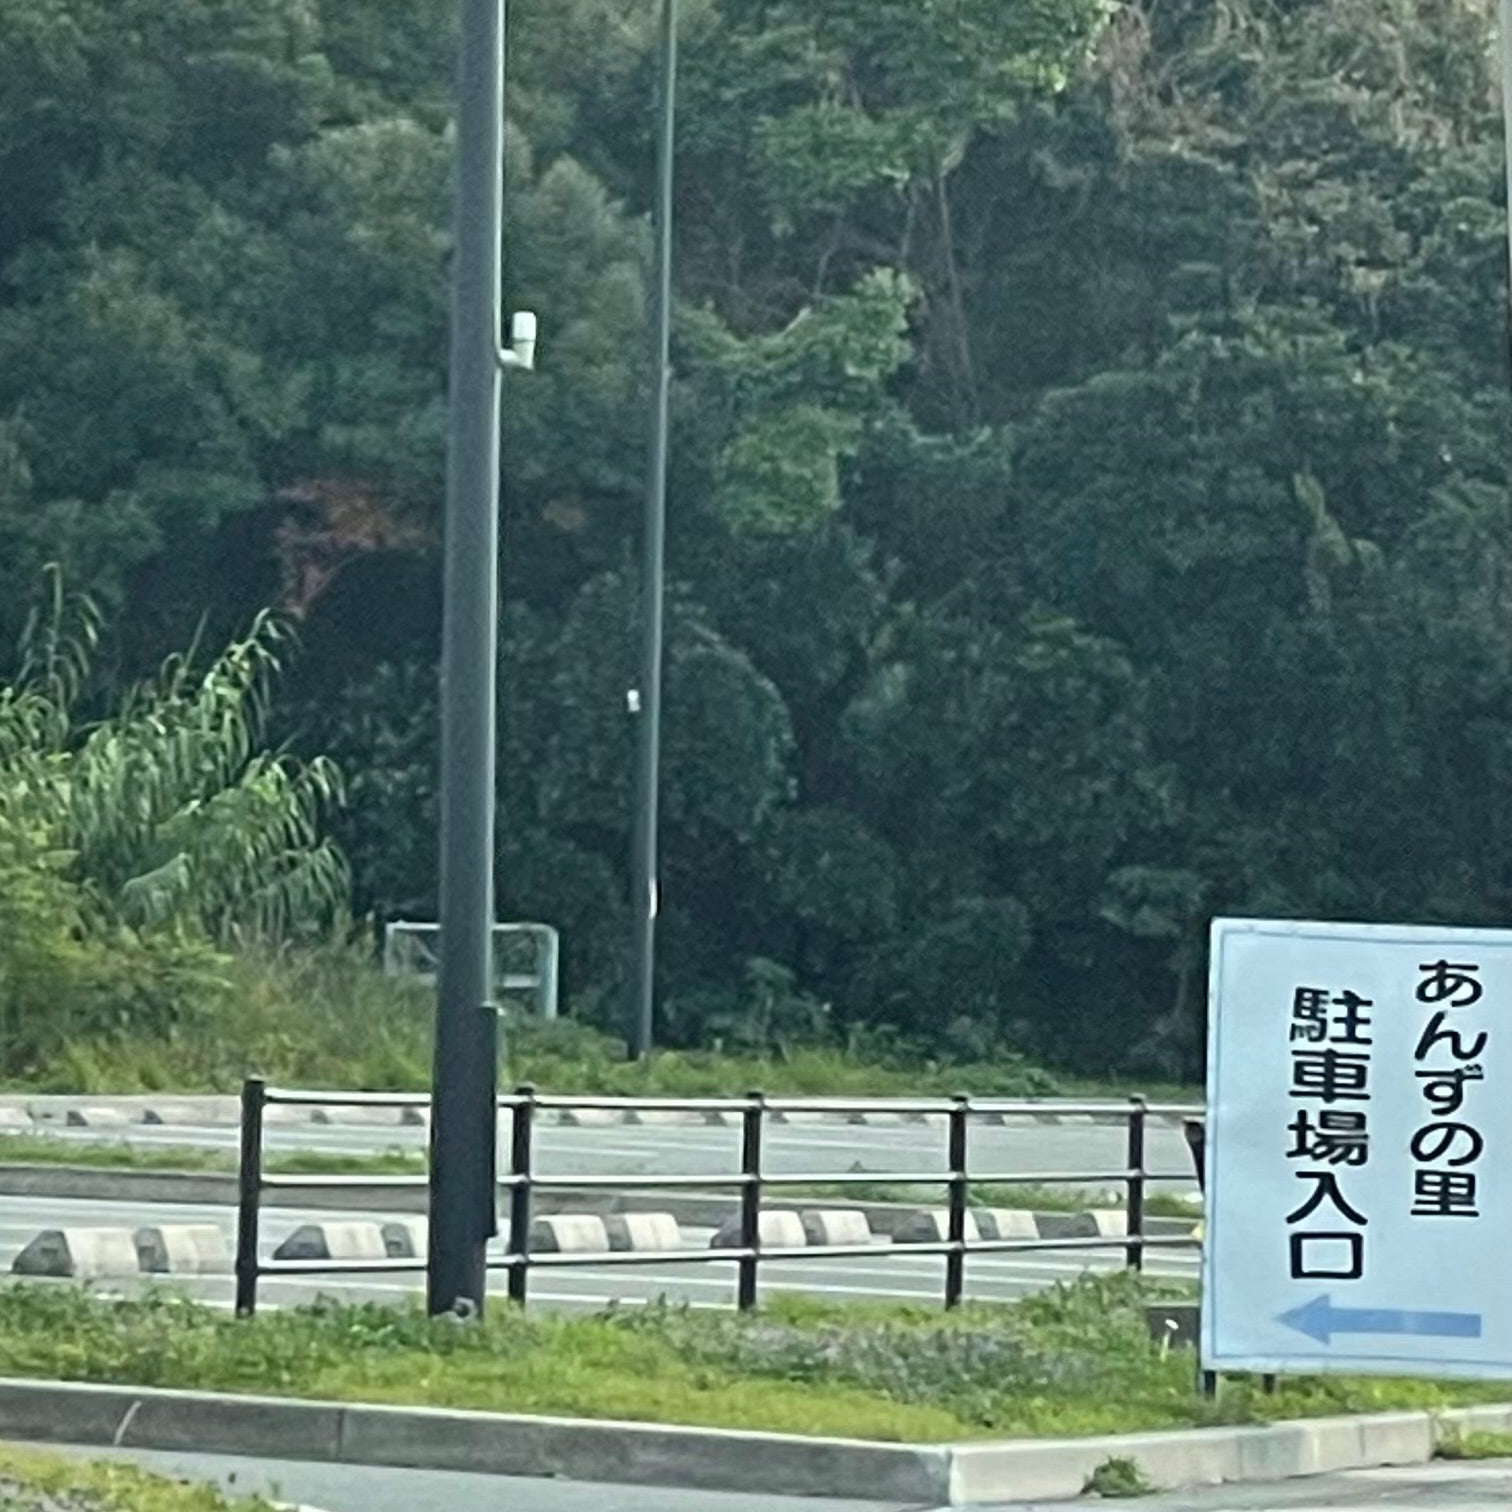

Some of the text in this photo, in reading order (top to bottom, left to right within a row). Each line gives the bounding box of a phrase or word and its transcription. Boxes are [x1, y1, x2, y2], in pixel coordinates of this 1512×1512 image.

[1285, 986, 1374, 1280] 駐車場入口
[1410, 959, 1488, 1218] あんずの里
